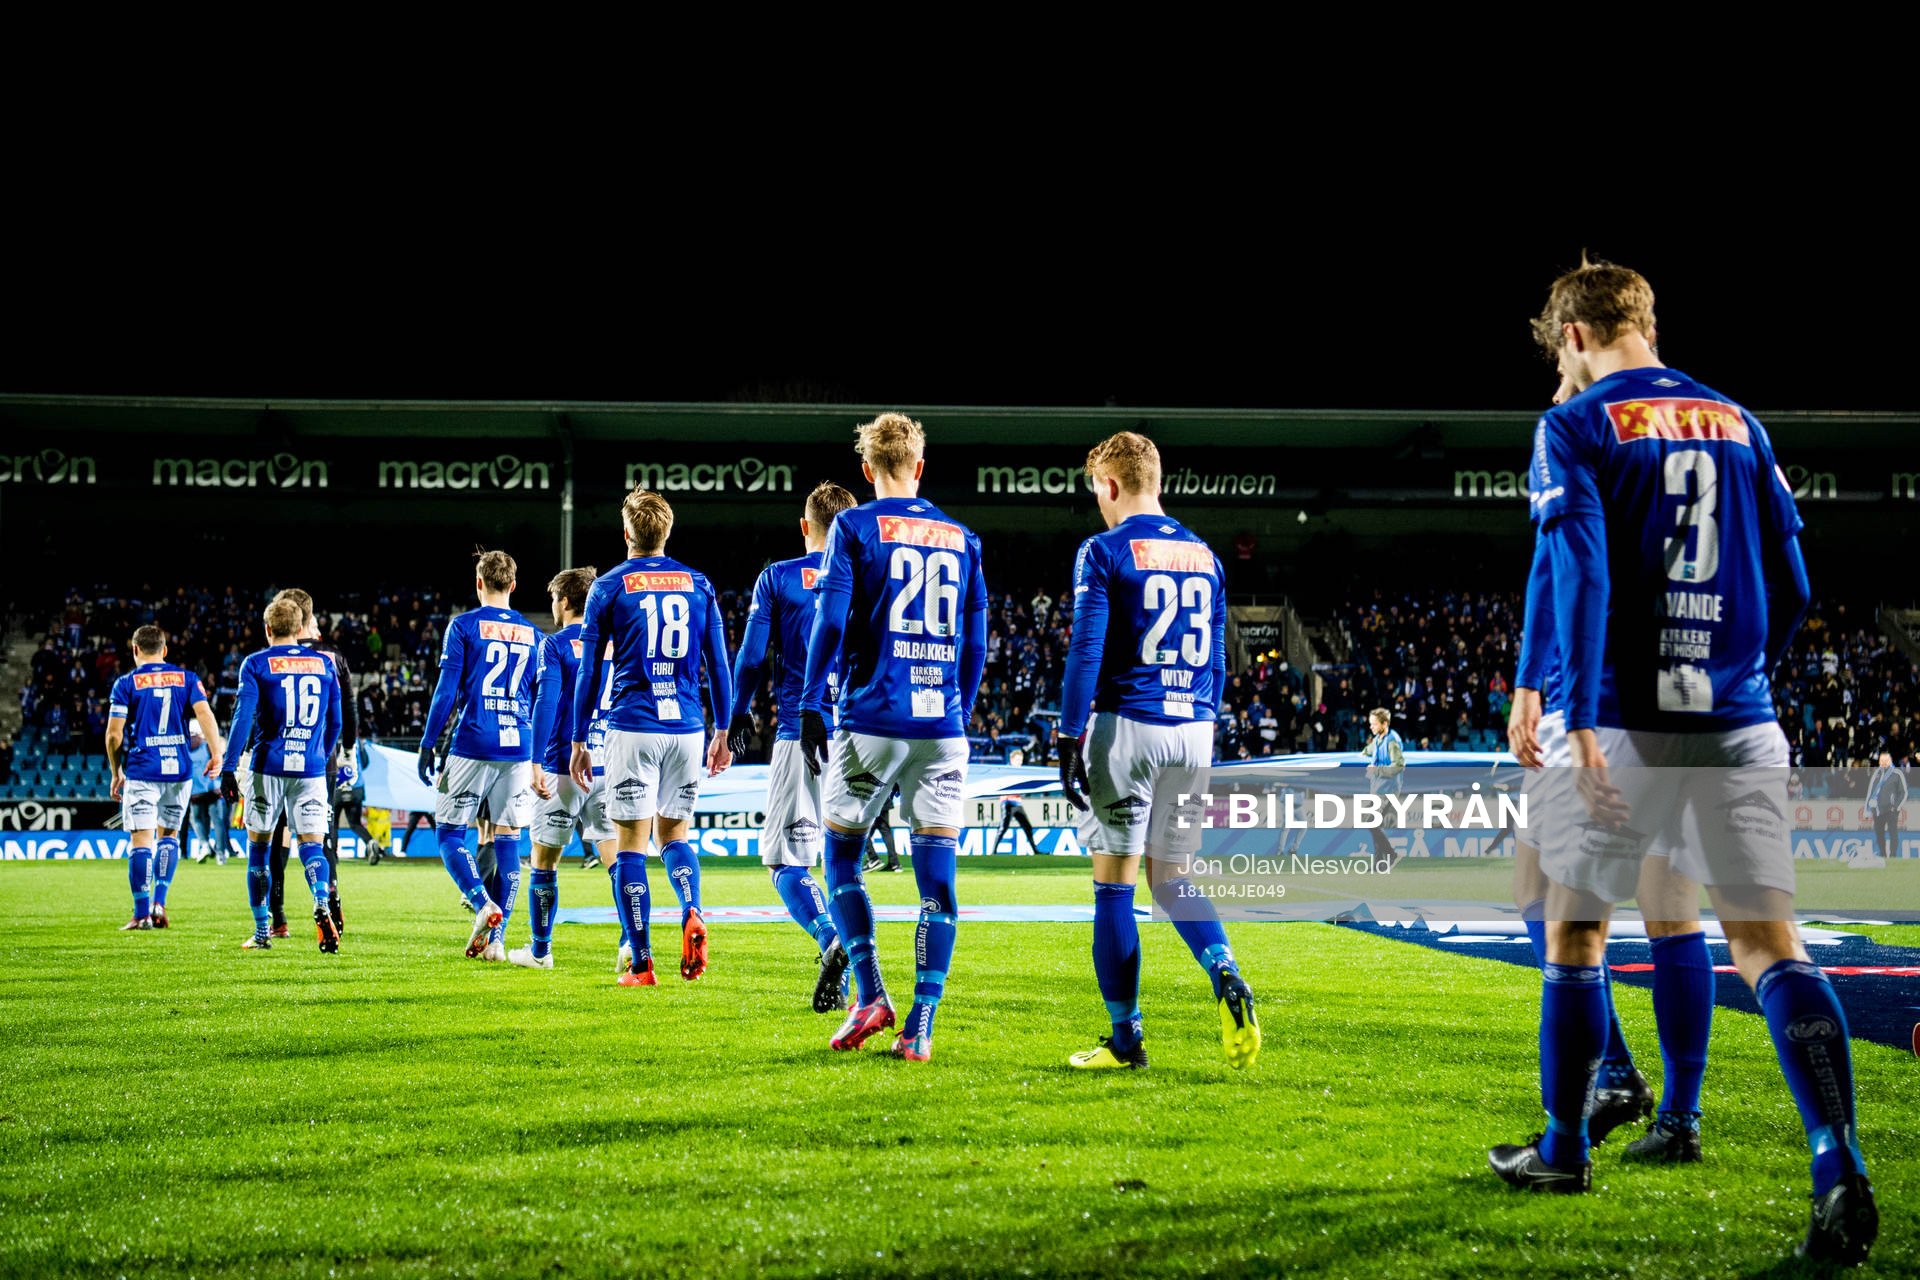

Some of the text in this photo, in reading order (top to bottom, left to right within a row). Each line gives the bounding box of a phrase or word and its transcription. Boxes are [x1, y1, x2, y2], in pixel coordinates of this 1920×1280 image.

[152, 452, 328, 488] macron
[378, 454, 549, 490] macron
[625, 457, 792, 492] macron
[976, 466, 1276, 495] macr ribunen
[1664, 449, 1719, 584] 3
[651, 576, 690, 586] EXTRA
[889, 547, 960, 638] 26
[639, 594, 690, 659] 18
[1141, 574, 1212, 667] 23
[482, 641, 530, 698] 27
[652, 662, 675, 676] FURU
[893, 640, 956, 662] SOLBAKKEN
[911, 666, 943, 676] KIRKENS
[153, 688, 172, 735] 7
[281, 675, 322, 728] 16
[916, 927, 929, 966] SIVERTSEN
